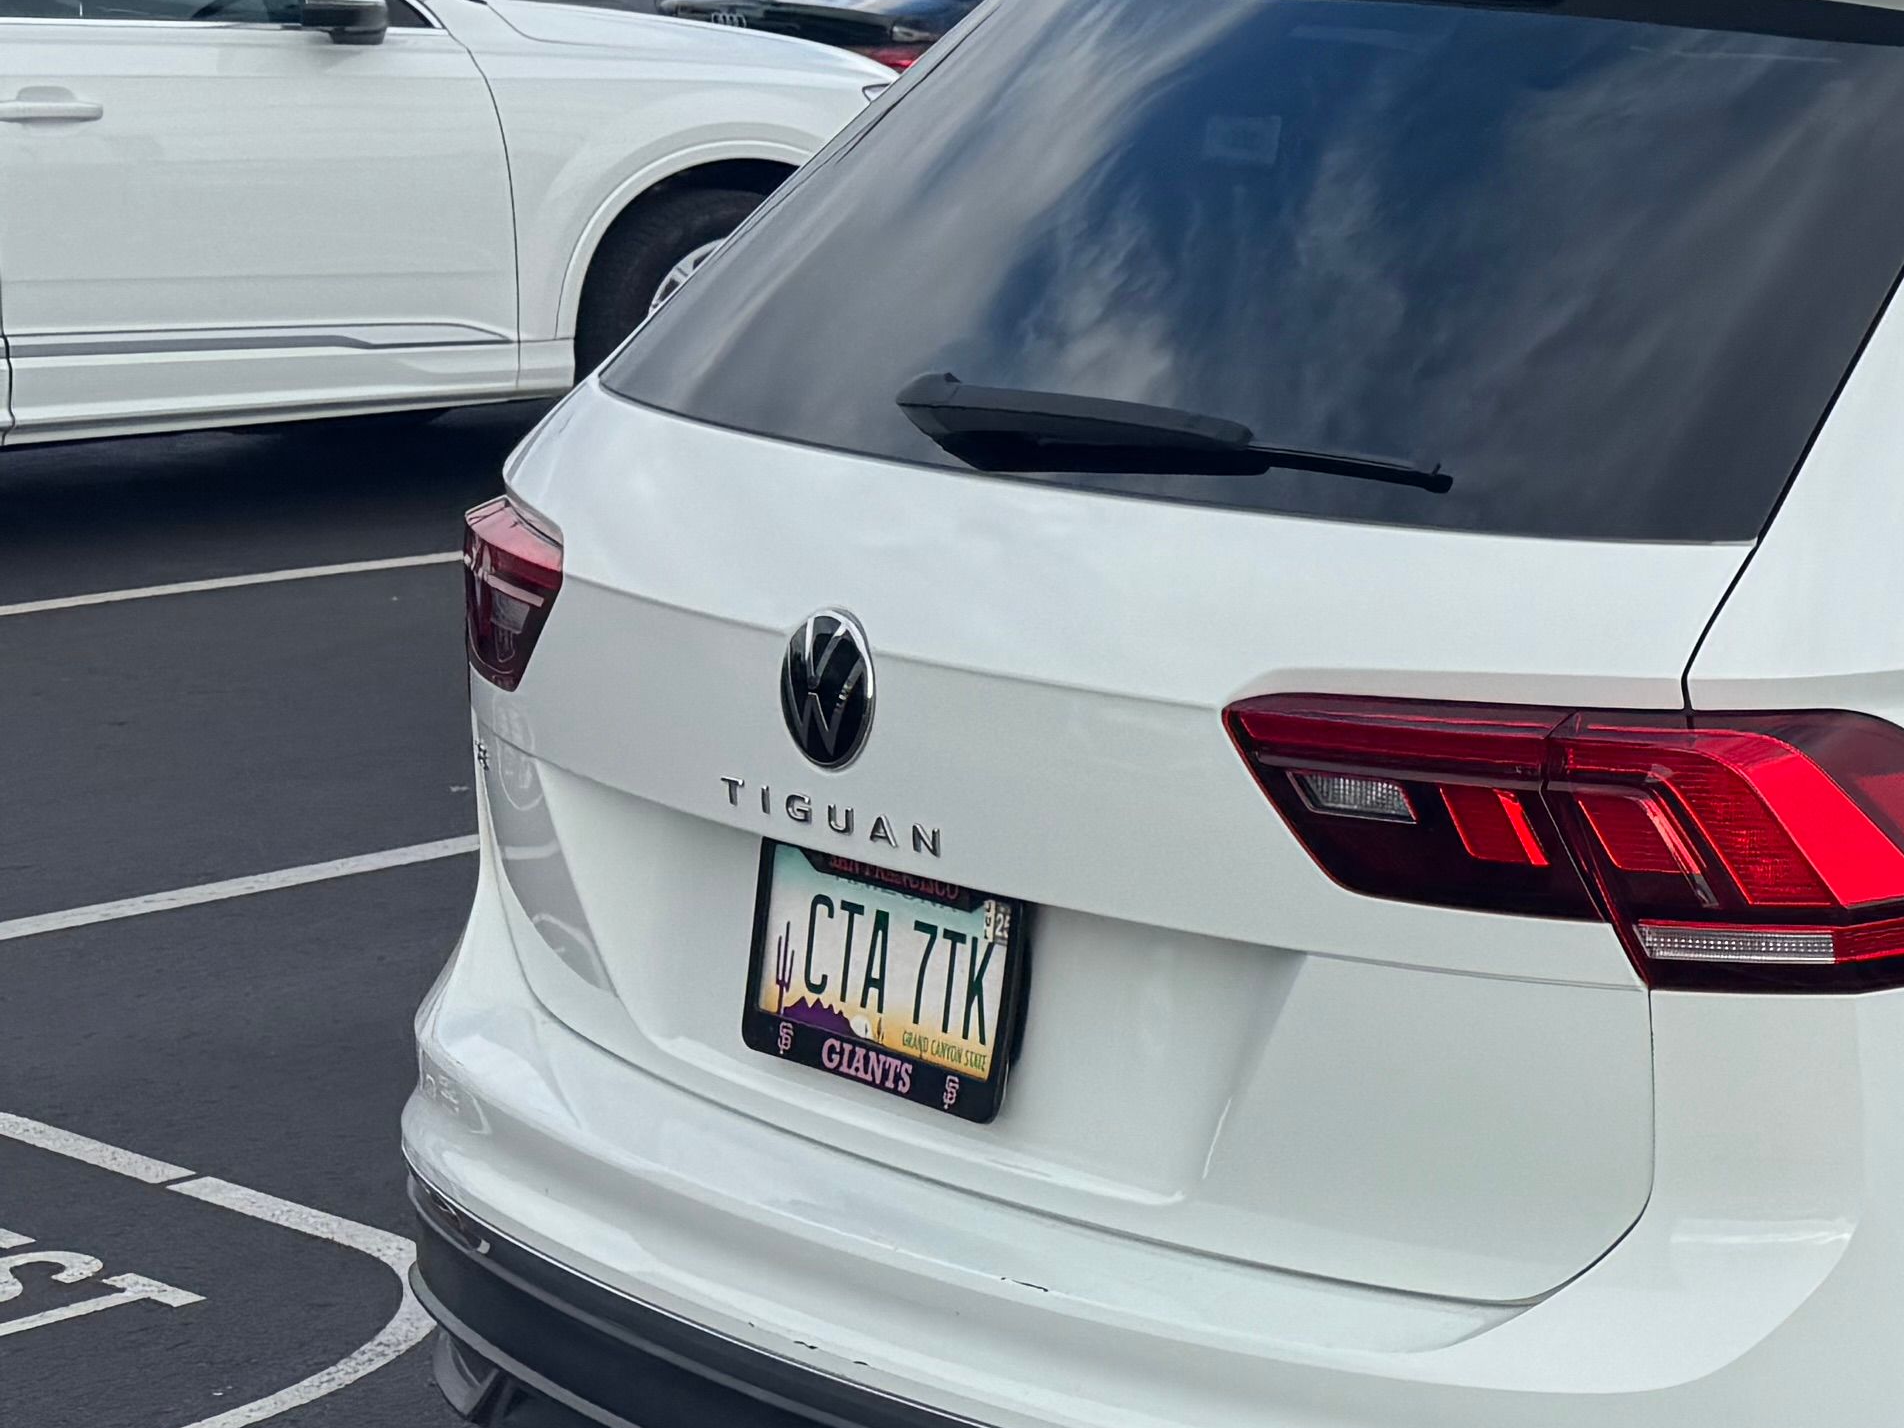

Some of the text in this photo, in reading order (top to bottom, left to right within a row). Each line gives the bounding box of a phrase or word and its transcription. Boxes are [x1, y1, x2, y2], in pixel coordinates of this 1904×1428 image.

[720, 776, 943, 859] TIGUAN
[803, 893, 996, 1047] CTA 7TK
[820, 1037, 914, 1095] GIANTS
[902, 1031, 988, 1072] GRAND CANYON STATE
